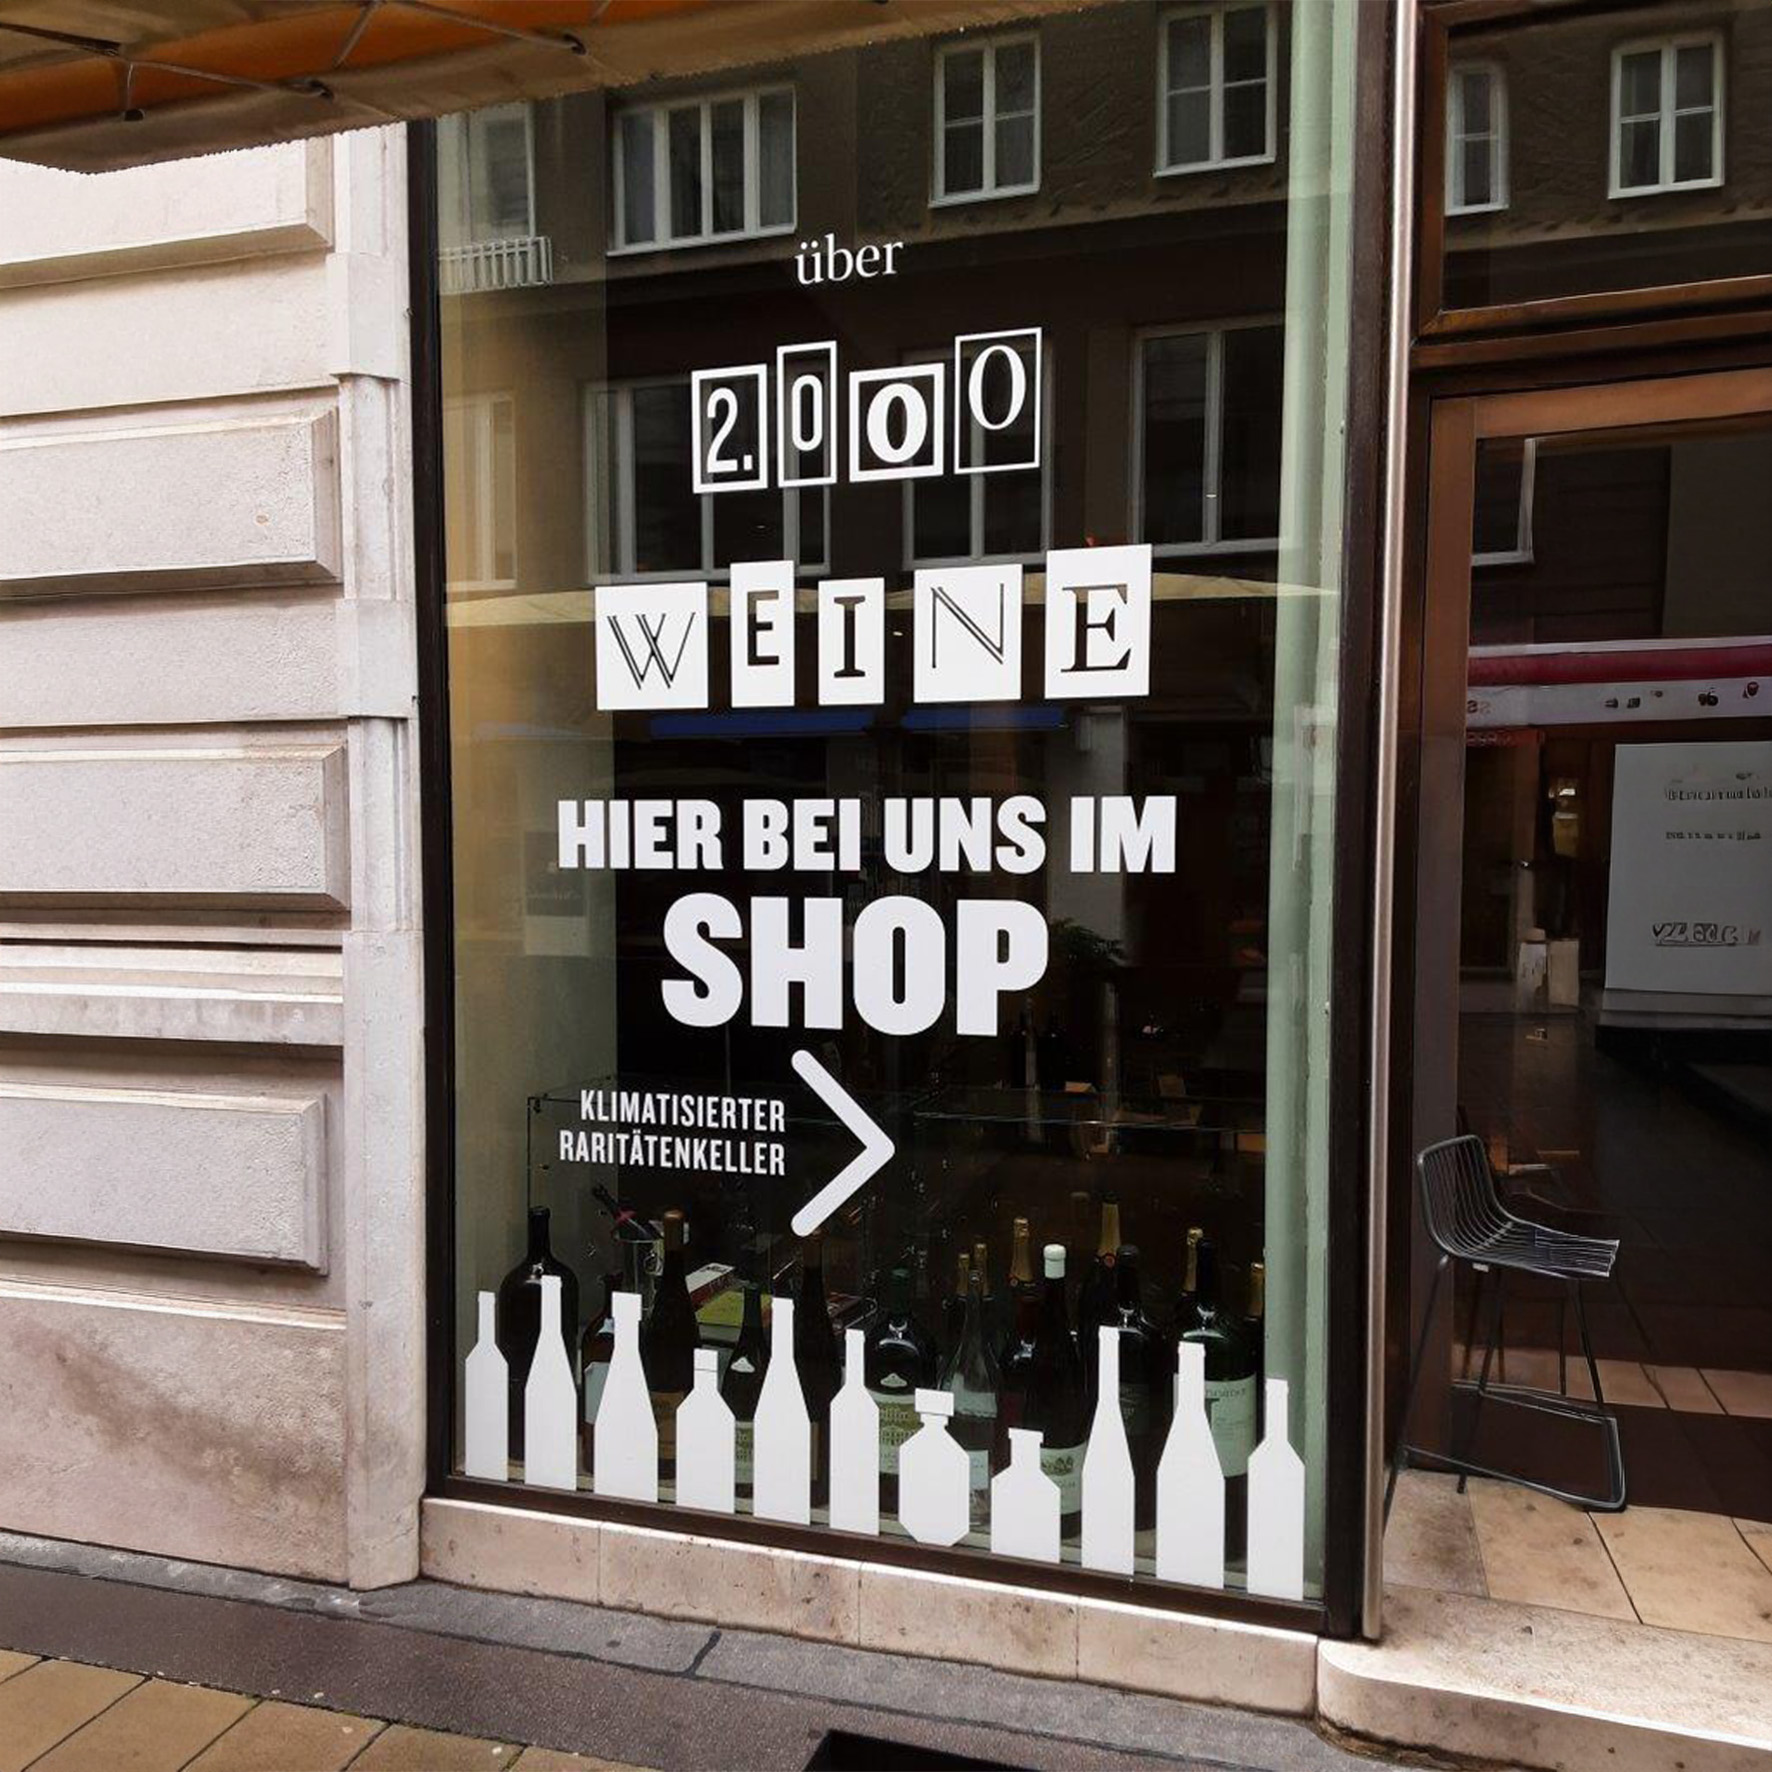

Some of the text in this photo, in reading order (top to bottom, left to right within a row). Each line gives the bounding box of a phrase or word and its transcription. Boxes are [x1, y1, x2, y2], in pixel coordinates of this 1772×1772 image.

[796, 233, 904, 285] über
[606, 584, 1132, 690] WEINE
[558, 796, 1176, 874] HIER BEI UNS IM
[661, 892, 1049, 1036] SHOP
[581, 1089, 785, 1132] KLIMATISIERTER
[559, 1128, 785, 1176] RARITÄTENKELLER
